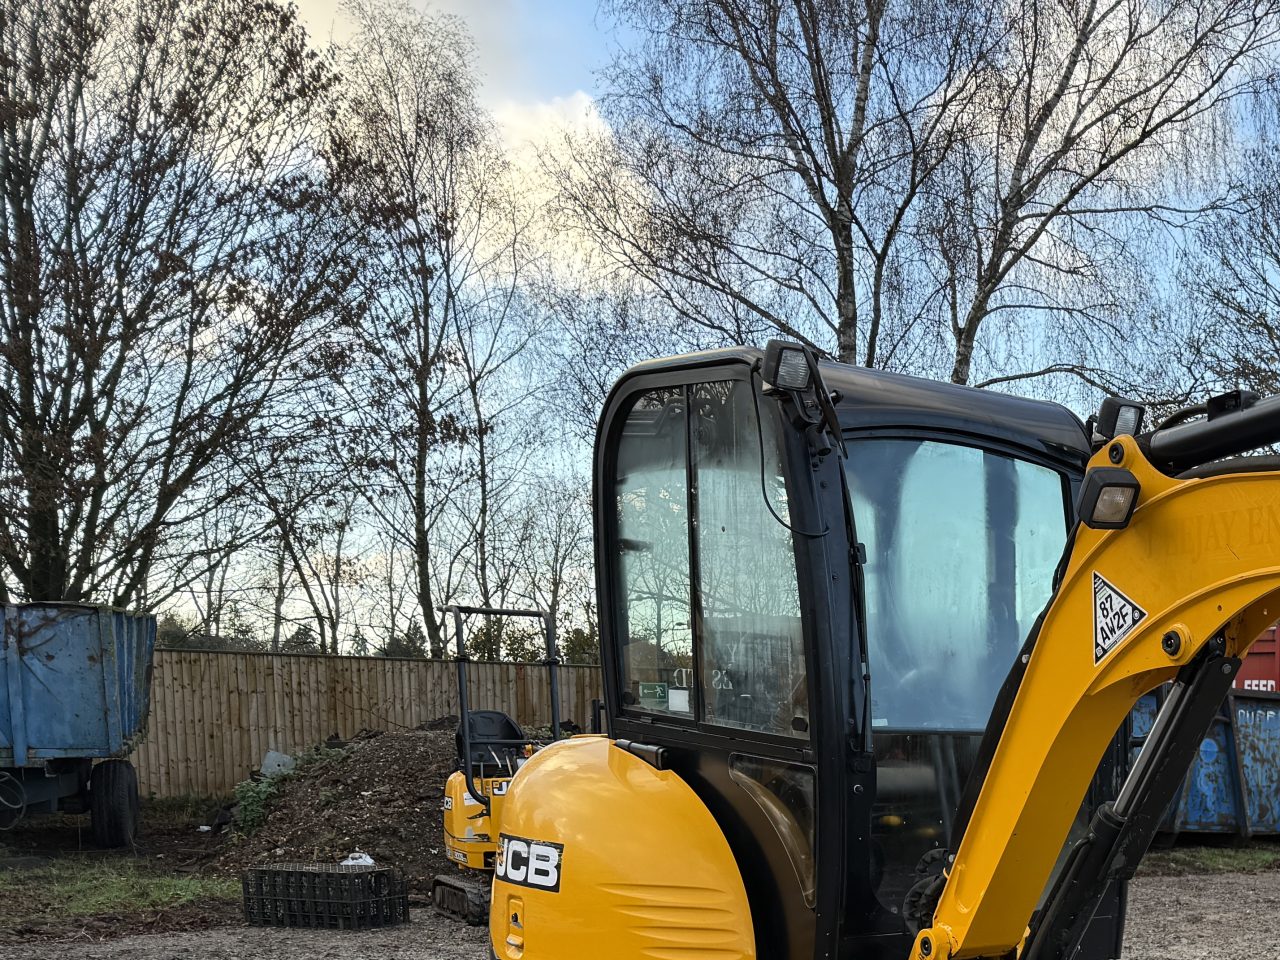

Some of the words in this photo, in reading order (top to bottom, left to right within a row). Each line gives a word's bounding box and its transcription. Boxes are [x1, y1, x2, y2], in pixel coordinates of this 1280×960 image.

[1099, 593, 1113, 619] 87
[1099, 603, 1129, 645] AW2F
[496, 838, 559, 887] JCB
